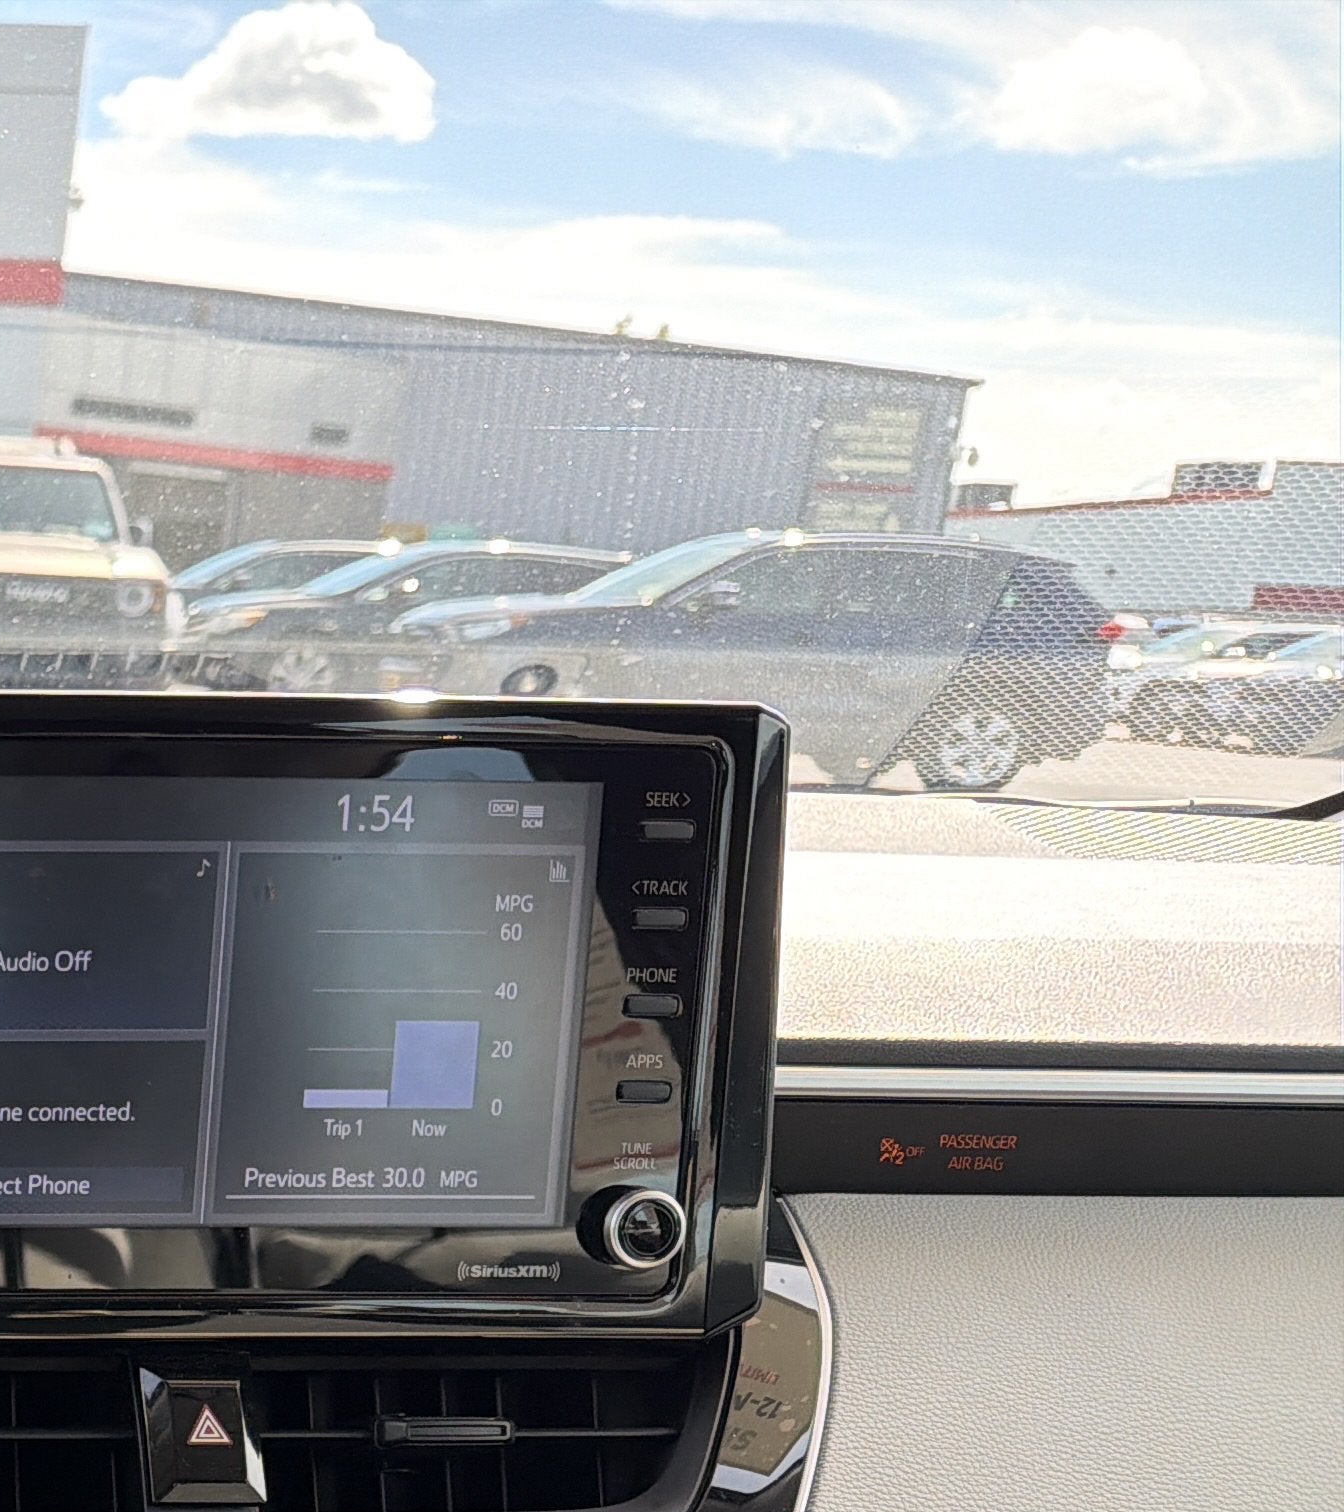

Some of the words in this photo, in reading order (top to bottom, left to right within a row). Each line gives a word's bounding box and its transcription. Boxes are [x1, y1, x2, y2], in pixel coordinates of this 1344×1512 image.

[337, 793, 415, 833] 1:54
[492, 803, 515, 813] DCM
[521, 818, 544, 828] DCM
[495, 896, 534, 913] MPG
[500, 923, 523, 943] 60
[54, 950, 92, 972] Off
[626, 968, 678, 984] PHONE
[495, 981, 518, 1000] 40
[491, 1040, 513, 1058] 20
[626, 1054, 664, 1069] APPS
[27, 1101, 136, 1123] connected.
[491, 1098, 503, 1117] 0
[324, 1118, 352, 1140] Trip
[355, 1119, 363, 1137] 1
[412, 1119, 448, 1138] Now
[621, 1141, 653, 1156] TUNE
[939, 1134, 1018, 1150] PASSENGER
[906, 1146, 925, 1157] OFF
[613, 1156, 657, 1171] SCROLL
[947, 1156, 971, 1171] AIR
[974, 1156, 1004, 1171] BAG
[27, 1173, 90, 1195] Phone
[244, 1167, 326, 1189] Previous
[331, 1167, 375, 1189] Best
[382, 1168, 425, 1188] 30.0
[439, 1169, 478, 1188] MPG
